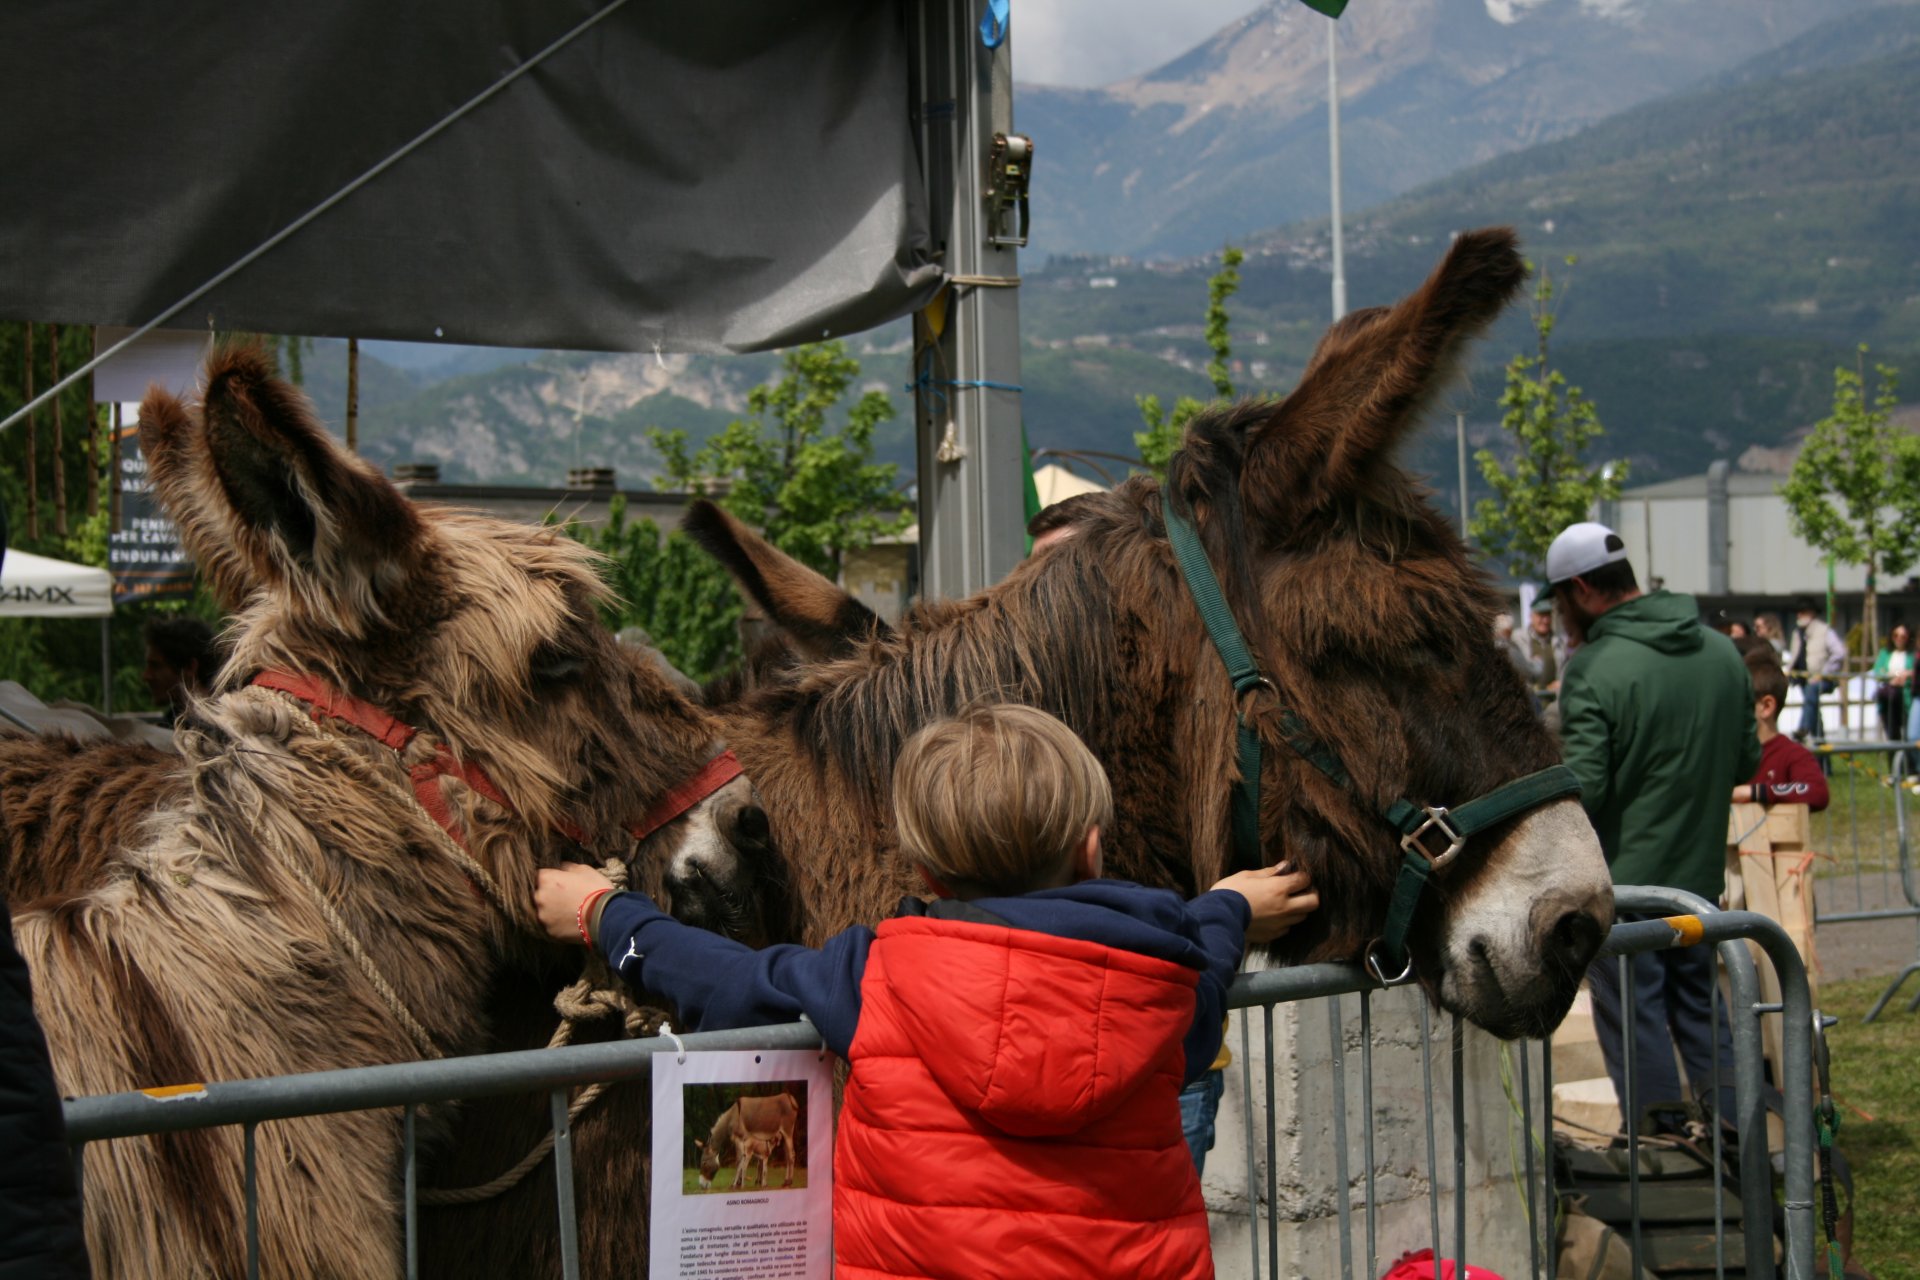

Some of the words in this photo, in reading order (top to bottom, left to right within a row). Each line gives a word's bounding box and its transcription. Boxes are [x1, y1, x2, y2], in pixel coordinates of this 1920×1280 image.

[112, 530, 137, 543] PER
[111, 549, 187, 563] ENDURAN
[0, 584, 76, 605] AMX
